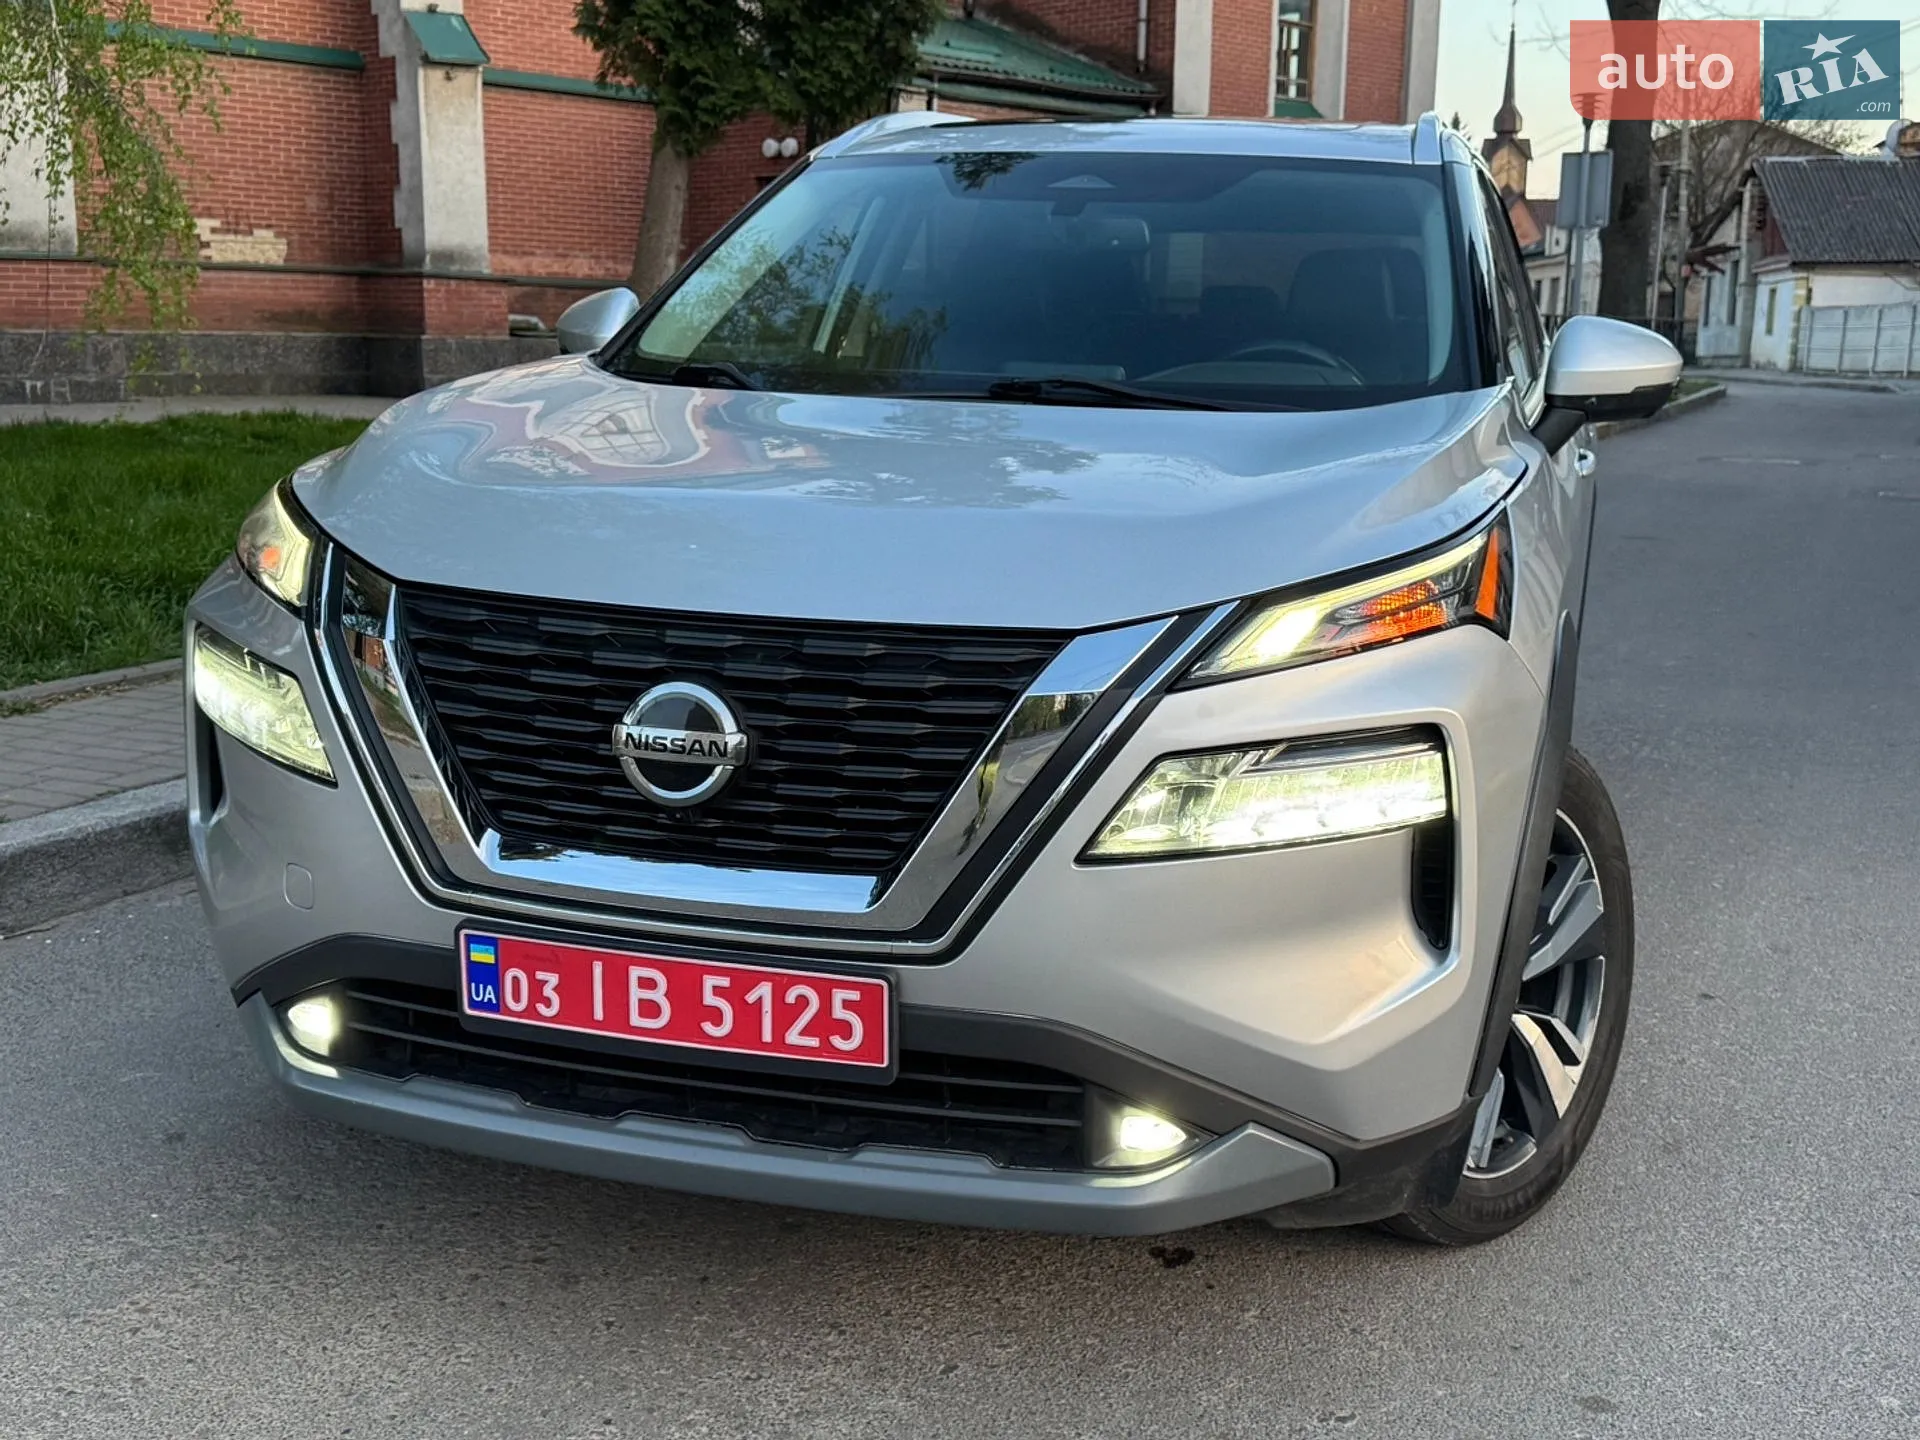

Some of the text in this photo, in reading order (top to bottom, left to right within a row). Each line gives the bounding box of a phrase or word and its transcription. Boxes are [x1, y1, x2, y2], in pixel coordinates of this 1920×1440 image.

[624, 732, 729, 758] NISSAN
[471, 982, 497, 1004] UA
[504, 960, 864, 1051] 03 IB 5125
